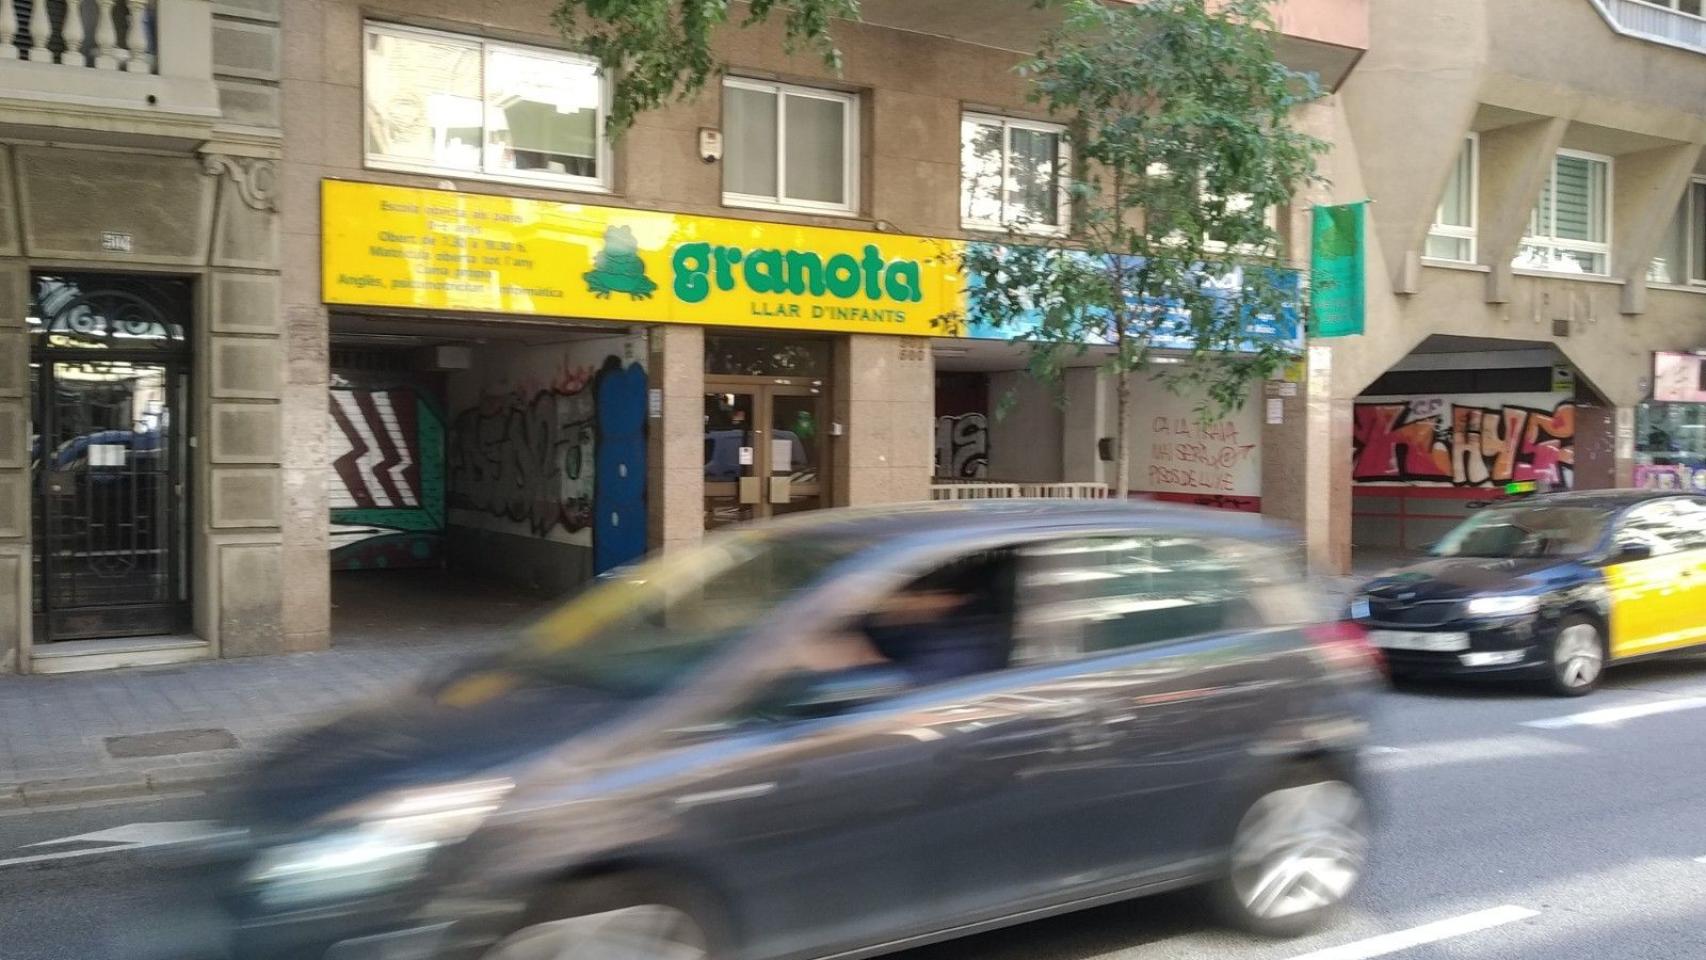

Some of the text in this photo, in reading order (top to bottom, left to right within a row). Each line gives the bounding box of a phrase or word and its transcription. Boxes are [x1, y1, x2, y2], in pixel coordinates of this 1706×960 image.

[673, 242, 922, 303] granota
[751, 303, 905, 323] LLAR D'INFANTS
